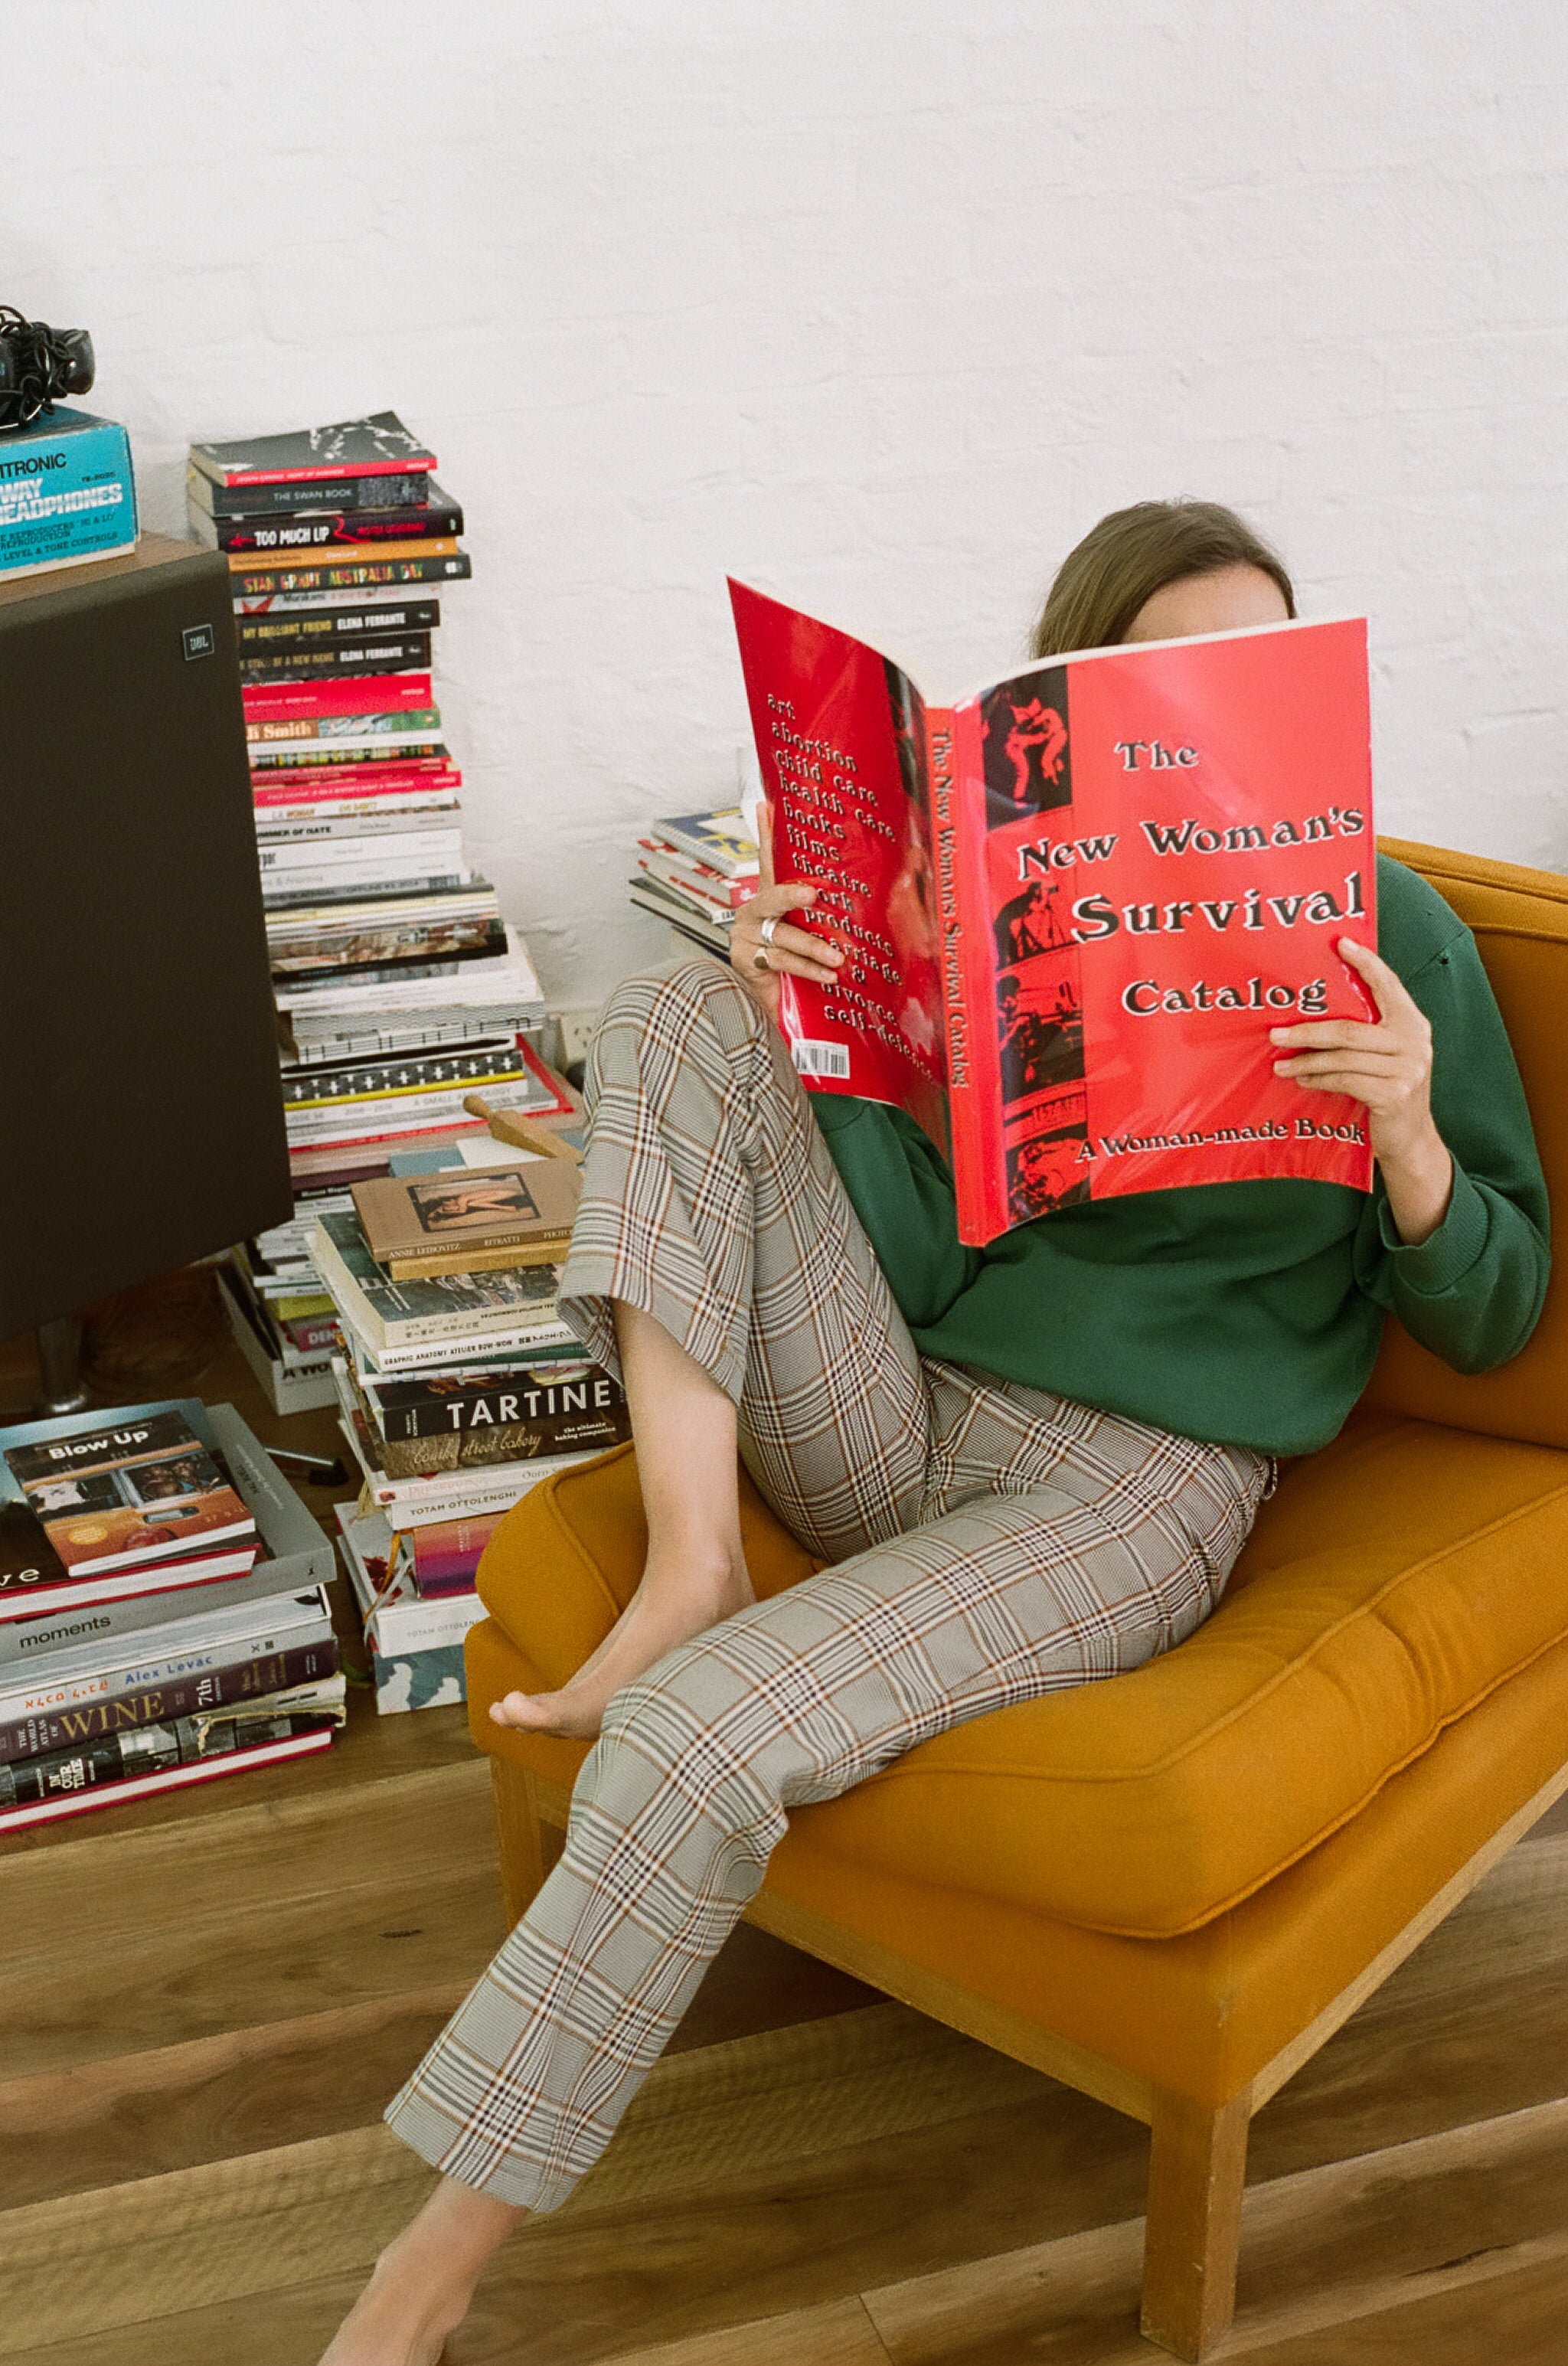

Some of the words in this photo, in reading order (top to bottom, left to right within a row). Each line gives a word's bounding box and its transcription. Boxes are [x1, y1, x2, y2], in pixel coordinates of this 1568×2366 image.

[274, 492, 291, 502] THE
[294, 490, 323, 500] SWAN
[326, 489, 352, 498] BOOK
[254, 529, 277, 547] TOO
[279, 528, 312, 544] MUCH
[243, 576, 276, 594] STAN
[281, 571, 322, 590] GRANT
[329, 565, 394, 585] AUSTRALIA
[189, 636, 209, 651] JBL
[767, 693, 796, 721] art.
[263, 721, 312, 739] Smith
[772, 721, 858, 773] abortion
[931, 727, 952, 773] The
[1115, 741, 1199, 771] The
[775, 749, 823, 783] child
[833, 775, 879, 808] care.
[778, 770, 845, 816] health
[854, 808, 897, 843] care.
[933, 774, 954, 824] New
[782, 796, 846, 839] books
[786, 823, 841, 863] films
[1018, 834, 1119, 882] New
[1142, 806, 1364, 856] Woman's
[792, 851, 872, 899] theatre.
[937, 826, 959, 918] Woman's
[812, 885, 855, 913] ork
[1072, 871, 1366, 943] Survival
[804, 906, 894, 959] products
[812, 932, 903, 986] arriage.
[852, 964, 866, 984] &
[943, 921, 967, 1009] Survival
[1121, 976, 1329, 1016] Catalog
[949, 1012, 971, 1089] Catalog
[1076, 1140, 1098, 1164] A
[1099, 1119, 1289, 1157] Woman-made
[1295, 1116, 1366, 1146] Book
[389, 1247, 414, 1260] ANNIE
[416, 1243, 461, 1257] LEIBOVITZ
[416, 1348, 447, 1361] ANATOMY
[446, 1381, 612, 1430] TARTINE
[499, 1426, 543, 1457] bakery
[554, 1432, 578, 1443] baking
[580, 1426, 617, 1440] companion
[564, 1426, 577, 1435] the
[579, 1421, 607, 1433] ultimate
[49, 1439, 109, 1460] Blow
[113, 1430, 149, 1446] Up
[449, 1490, 518, 1510] OTTOLENGHI
[19, 1616, 112, 1649] moments
[437, 1619, 480, 1633] OTTOLEN
[125, 1668, 160, 1685] Alex
[167, 1655, 214, 1675] Levac
[195, 1678, 214, 1707] 7th
[59, 1691, 165, 1740] WINE
[48, 1774, 61, 1788] IN
[60, 1764, 73, 1789] OUR
[70, 1758, 86, 1789] TIME
